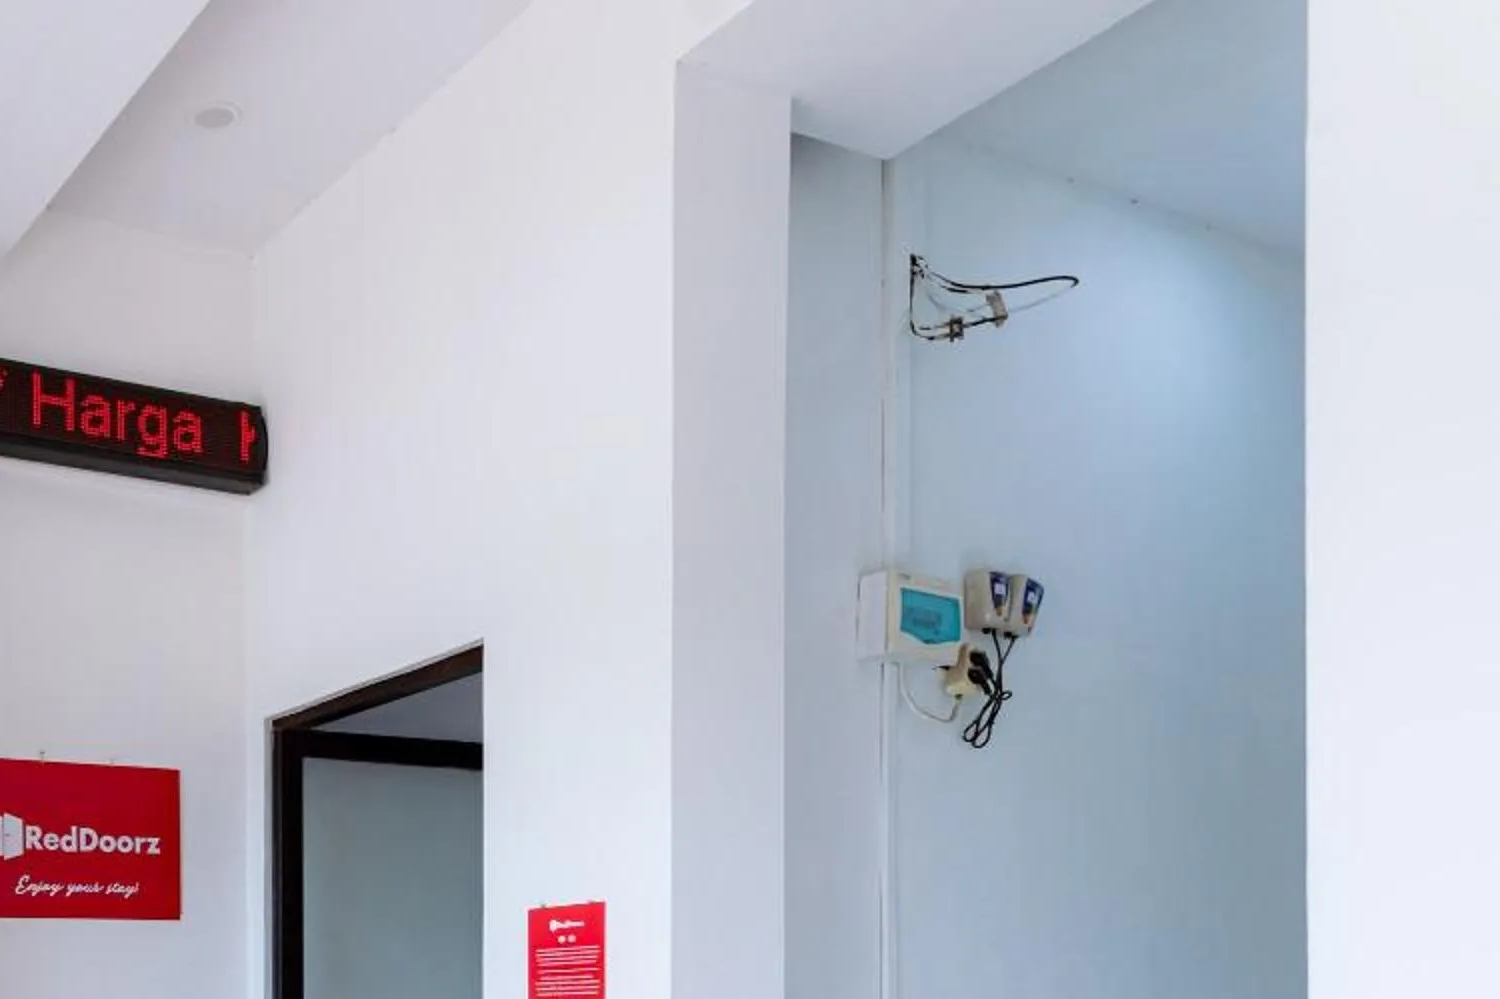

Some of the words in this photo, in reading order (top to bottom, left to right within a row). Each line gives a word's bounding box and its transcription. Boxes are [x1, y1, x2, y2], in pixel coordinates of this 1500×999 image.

[31, 372, 204, 459] Harga
[25, 825, 161, 855] RedDoorz
[15, 874, 64, 897] Enjoy
[65, 882, 104, 897] your
[105, 882, 139, 899] stay!
